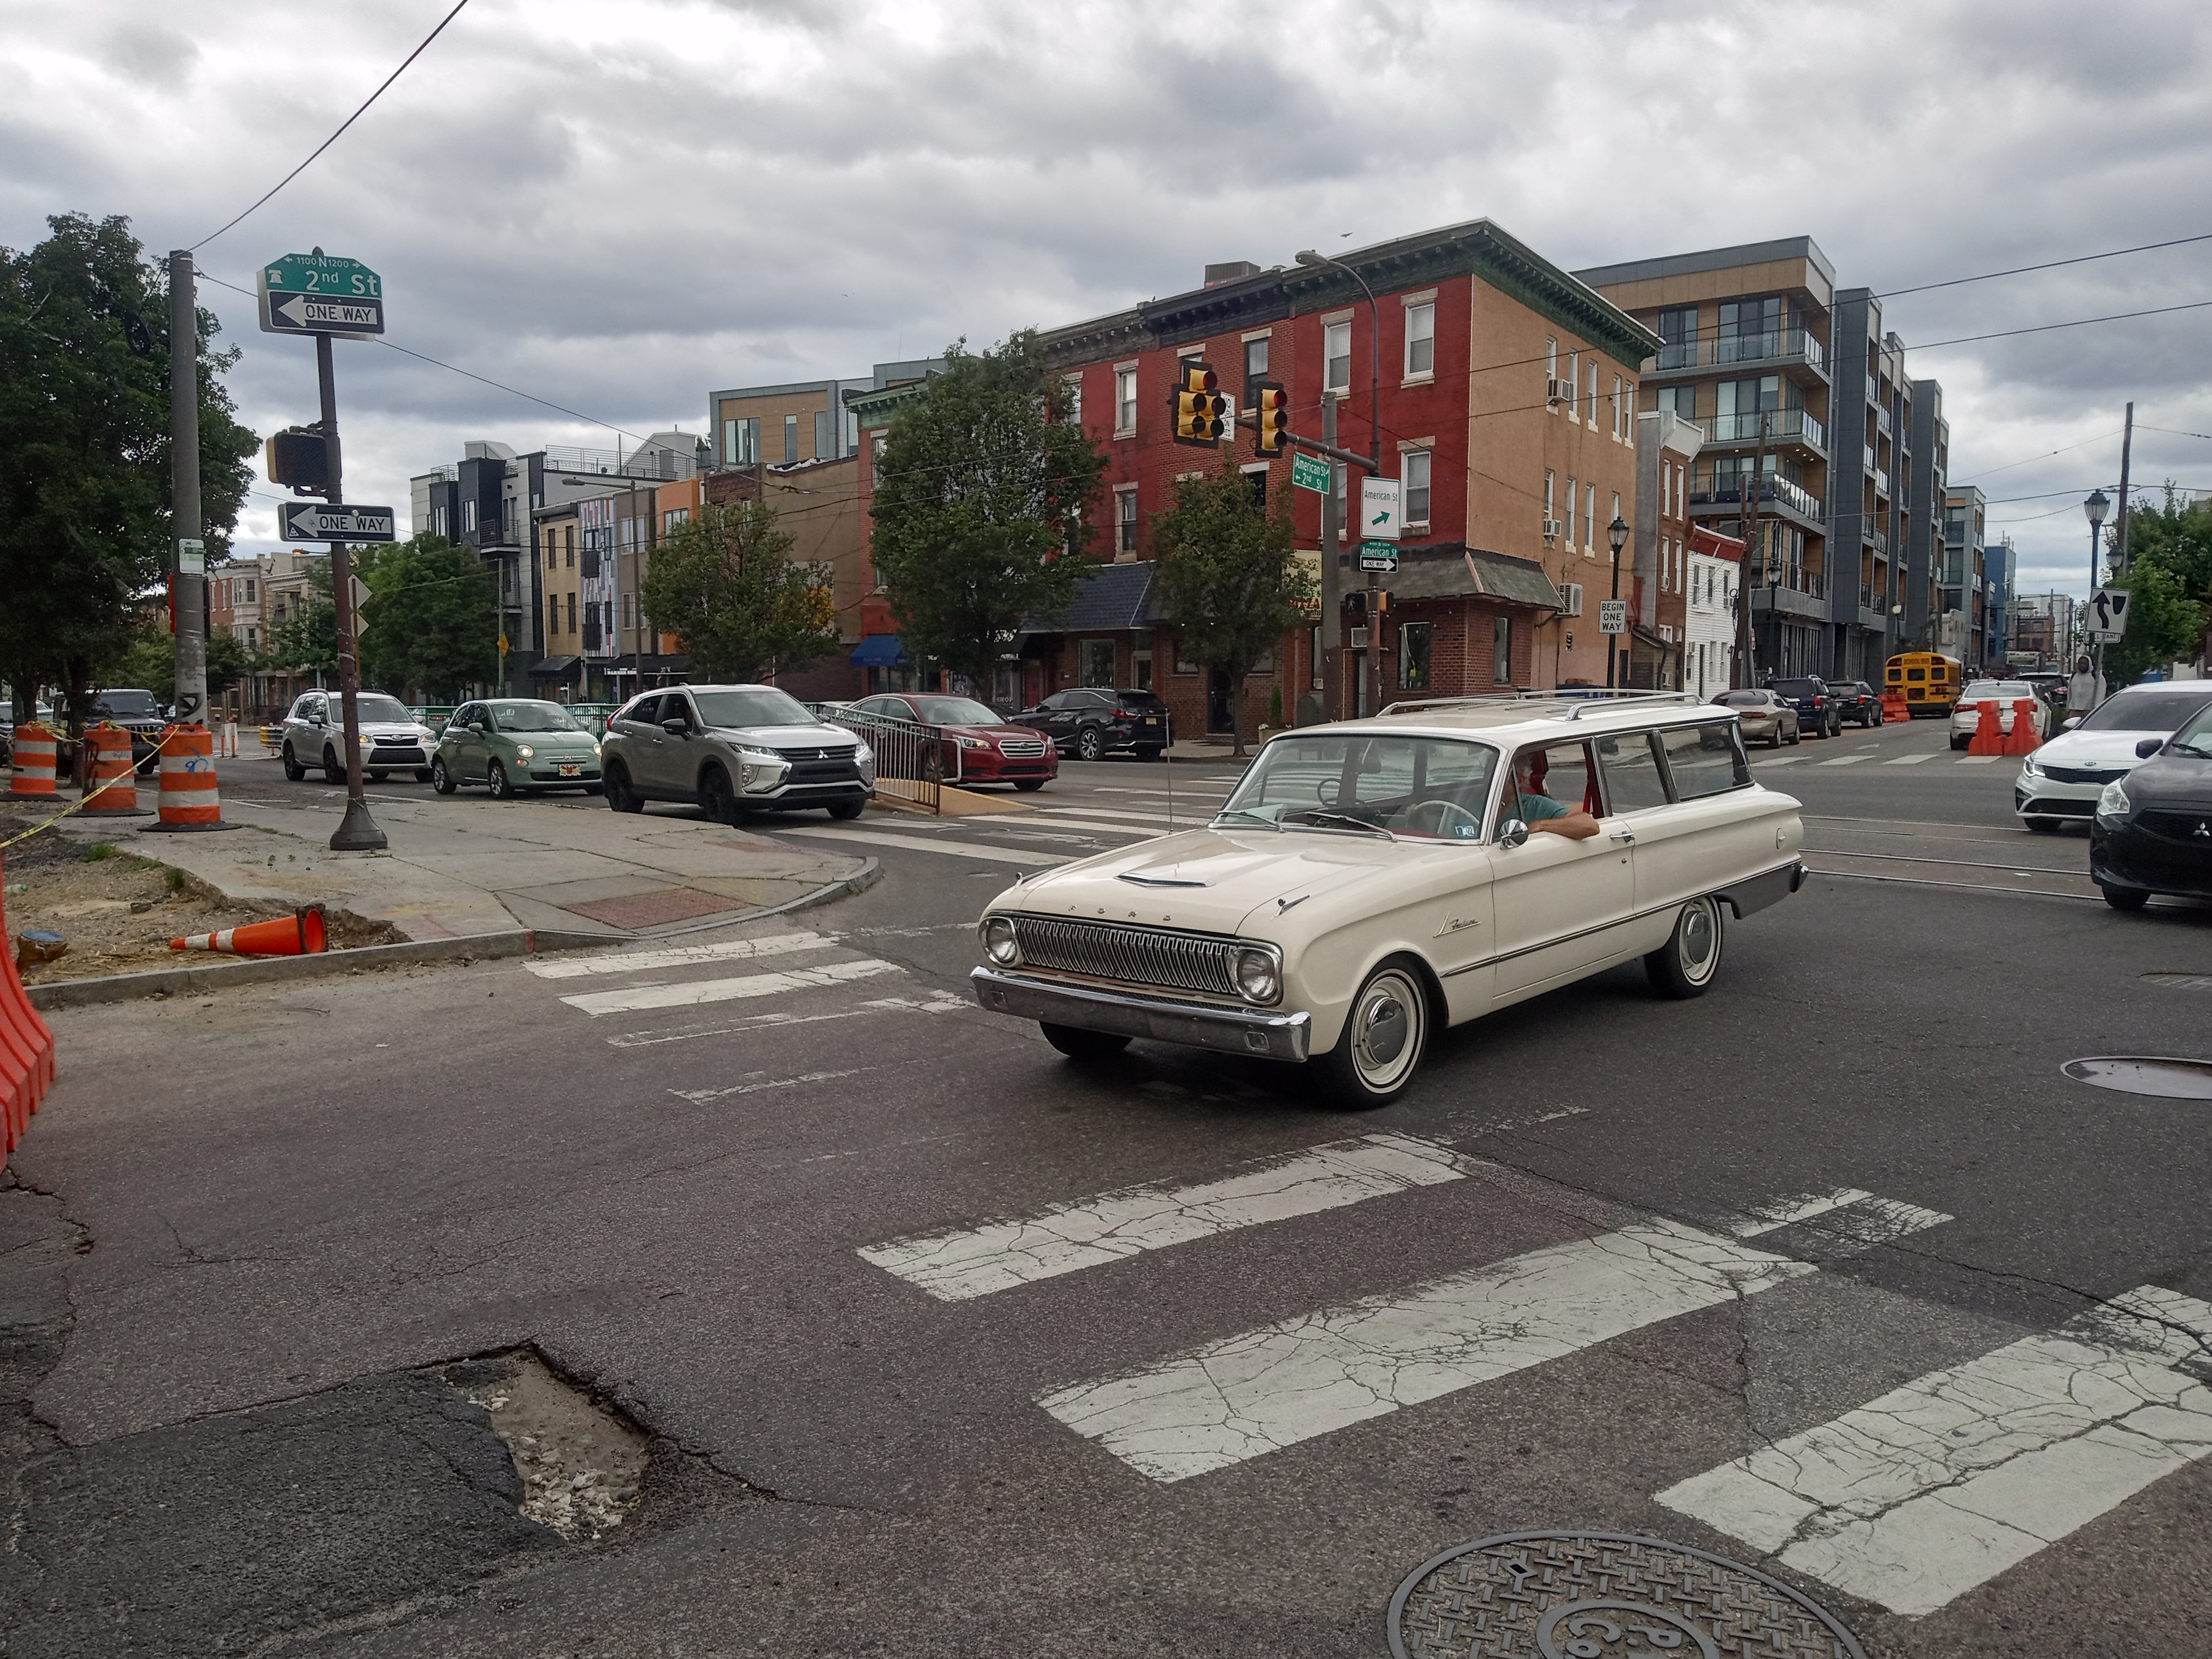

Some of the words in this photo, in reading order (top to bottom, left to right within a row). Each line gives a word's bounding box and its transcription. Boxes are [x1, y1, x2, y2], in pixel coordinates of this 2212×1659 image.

[297, 257, 317, 265] 1100
[319, 257, 327, 267] N
[328, 259, 349, 268] 1200
[305, 270, 339, 291] 2nd
[350, 274, 378, 296] St
[305, 304, 338, 320] ONE
[342, 307, 372, 322] WAY
[1295, 456, 1320, 476] American
[1321, 466, 1326, 477] St
[1302, 472, 1312, 484] 2nd
[1316, 478, 1322, 490] St
[1364, 490, 1390, 500] American
[1393, 492, 1398, 501] St
[320, 515, 348, 530] ONE
[356, 516, 385, 531] WAY
[1362, 546, 1389, 557] American
[1391, 548, 1397, 557] St
[1068, 904, 1172, 921] FORD
